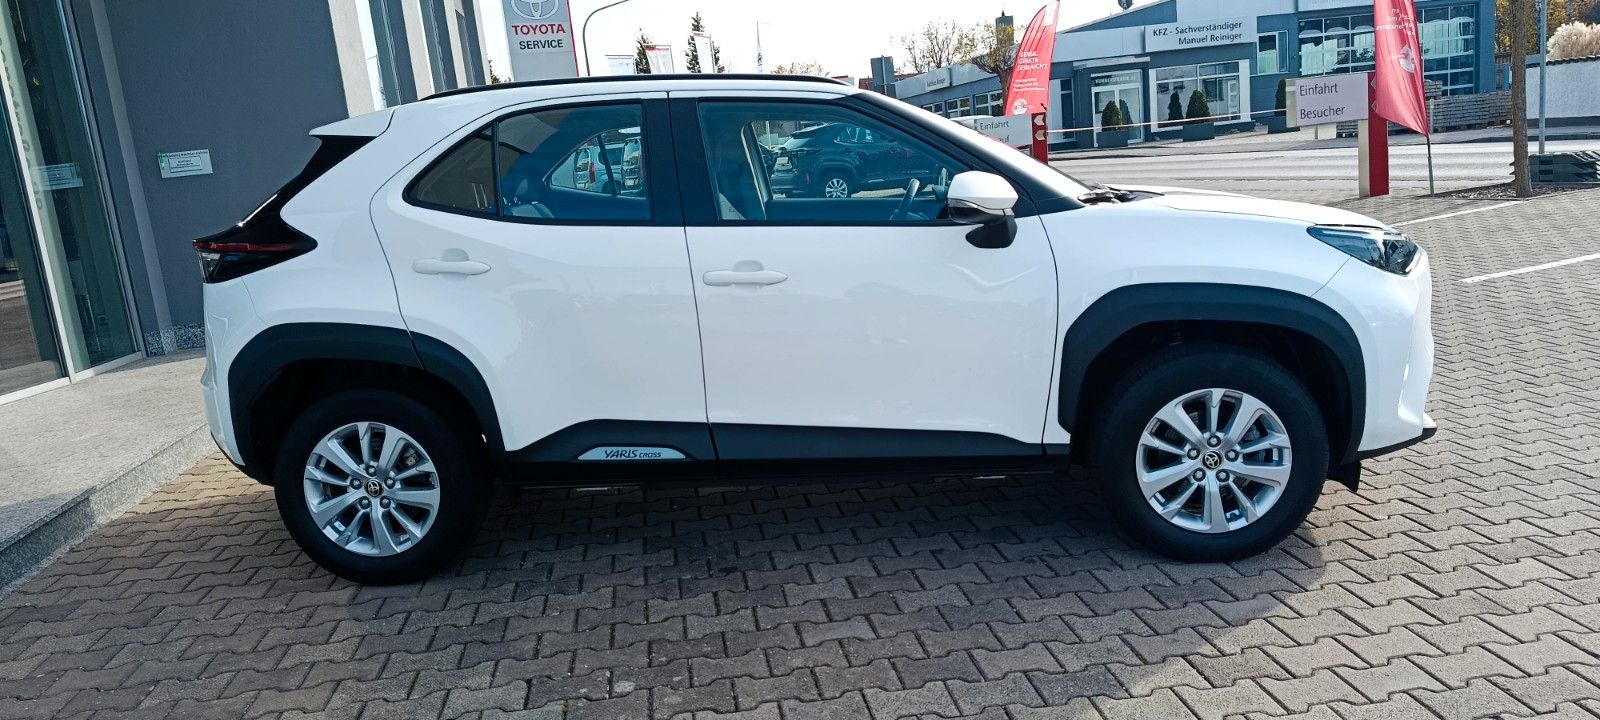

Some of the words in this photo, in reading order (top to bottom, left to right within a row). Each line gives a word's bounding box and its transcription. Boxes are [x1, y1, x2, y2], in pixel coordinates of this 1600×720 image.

[511, 24, 566, 35] TOYOTA
[1153, 27, 1168, 37] KFZ
[1175, 21, 1243, 34] Sachverständiger
[519, 39, 564, 50] SERVICE
[1178, 35, 1208, 45] Manuel
[1210, 33, 1243, 43] Reiniger
[1300, 83, 1338, 96] Einfahrt
[1300, 106, 1346, 119] Besucher
[980, 120, 1009, 131] Einfahrt
[604, 449, 638, 458] YARIS
